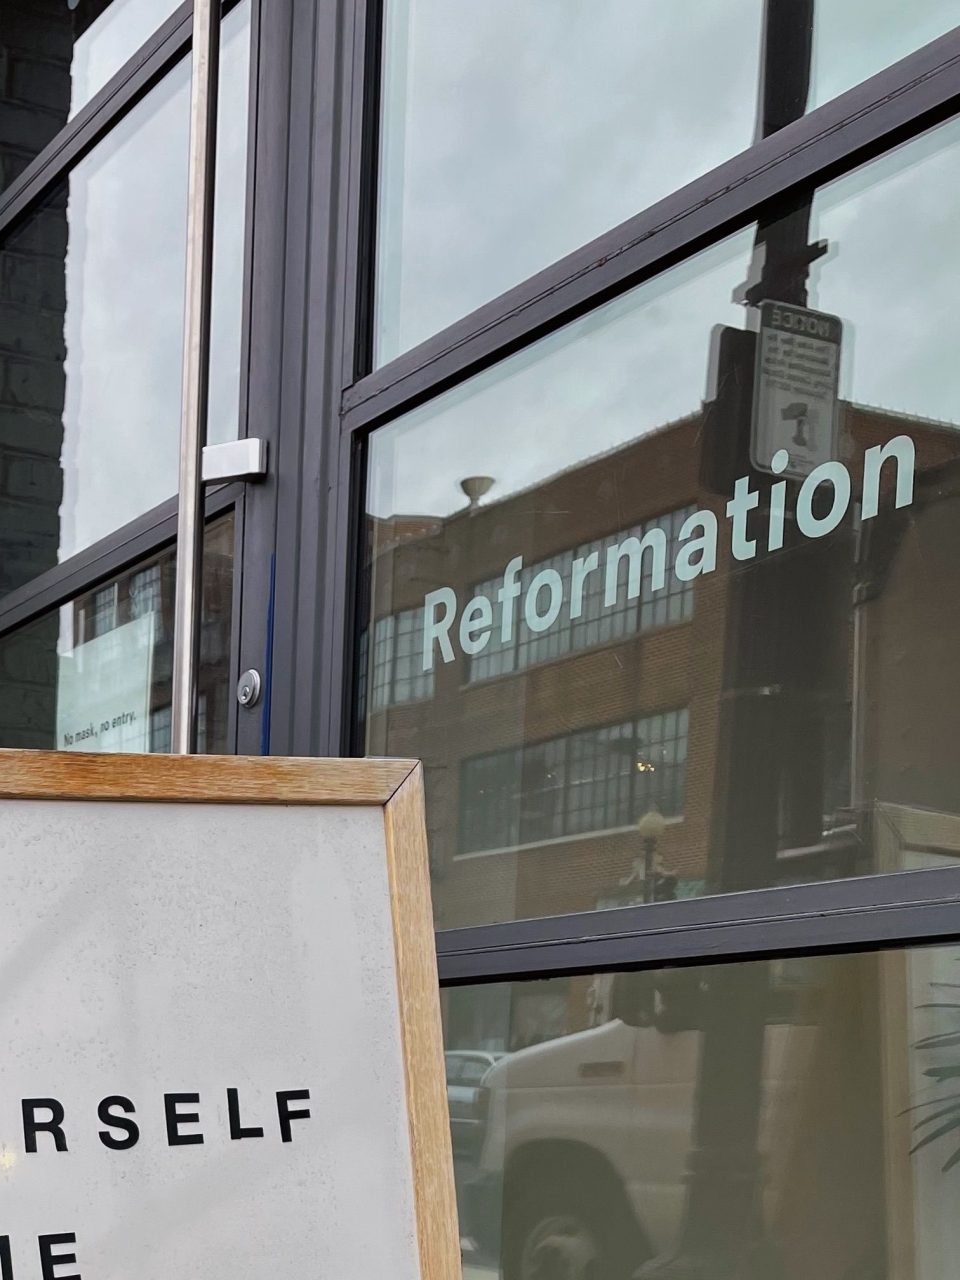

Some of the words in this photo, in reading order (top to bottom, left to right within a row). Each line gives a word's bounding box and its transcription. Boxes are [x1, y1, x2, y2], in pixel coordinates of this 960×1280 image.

[422, 435, 917, 671] Reformation
[64, 733, 74, 747] No
[75, 722, 98, 743] mask,
[100, 720, 110, 734] no
[112, 711, 137, 729] entry.
